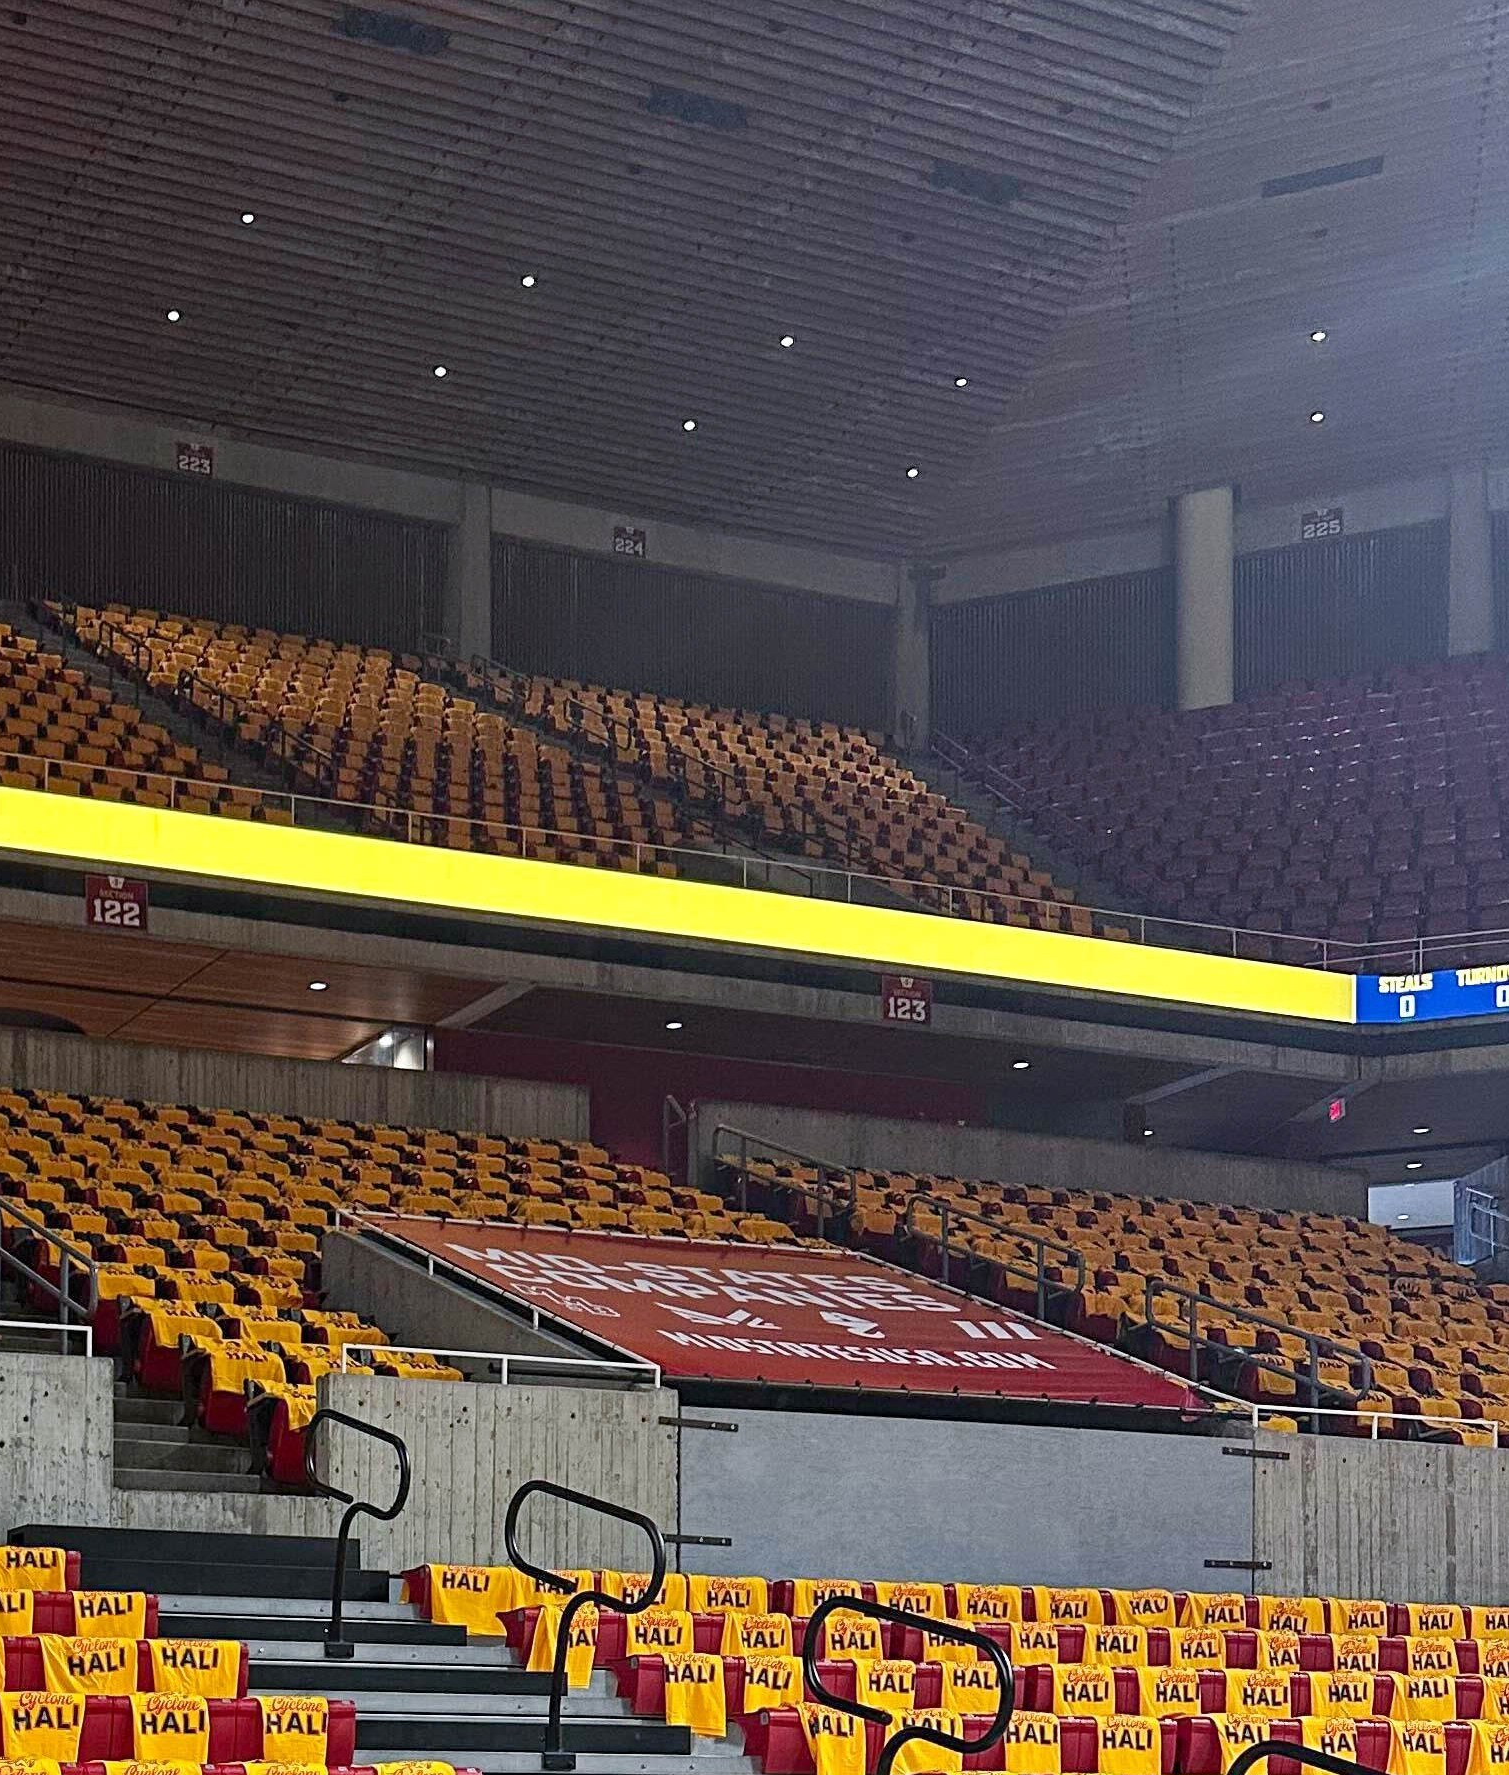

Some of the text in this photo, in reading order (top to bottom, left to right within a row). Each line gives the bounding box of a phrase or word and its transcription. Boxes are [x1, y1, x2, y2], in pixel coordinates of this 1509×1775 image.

[177, 454, 212, 475] 223
[1302, 518, 1342, 539] 225
[614, 537, 645, 556] 224
[93, 898, 140, 927] 122
[1378, 973, 1434, 994] STEALS
[1456, 963, 1509, 987] TURNO
[887, 996, 927, 1022] 123
[1398, 994, 1416, 1018] 0
[445, 1242, 915, 1295] MID-STATES
[485, 1262, 962, 1314] COMPANIES
[7, 1551, 57, 1568] HALI
[68, 1648, 124, 1677] HALI
[1065, 1681, 1108, 1703] HALI
[13, 1707, 79, 1732] HALI
[1004, 1717, 1058, 1744] HALI
